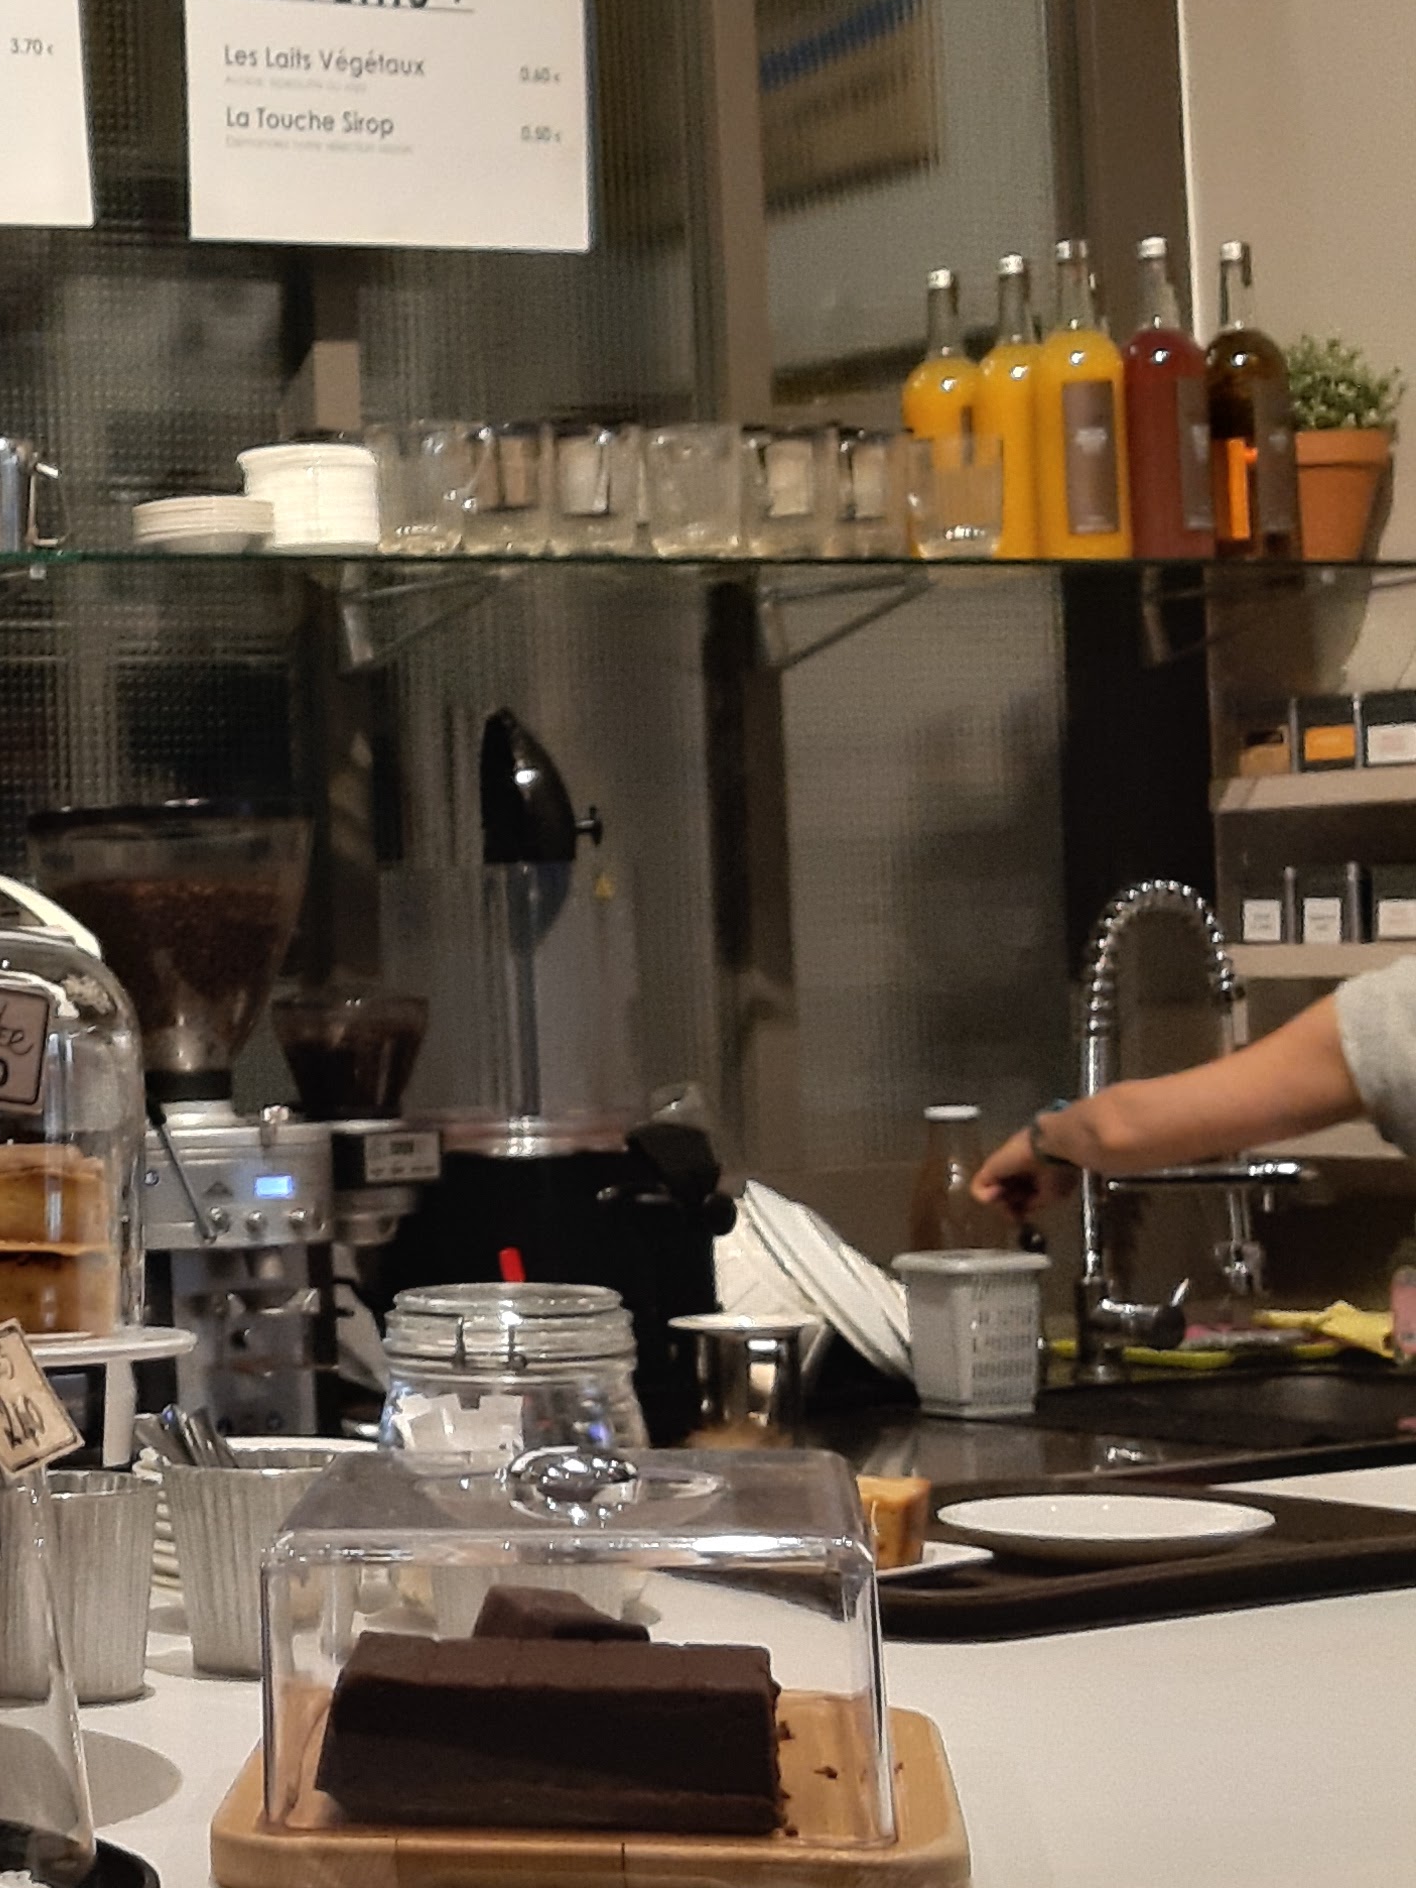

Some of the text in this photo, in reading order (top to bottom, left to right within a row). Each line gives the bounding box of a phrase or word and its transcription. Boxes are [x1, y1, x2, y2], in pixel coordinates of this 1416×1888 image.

[224, 44, 424, 78] Les Laits Végétaux
[226, 106, 394, 139] La Touche Sirop
